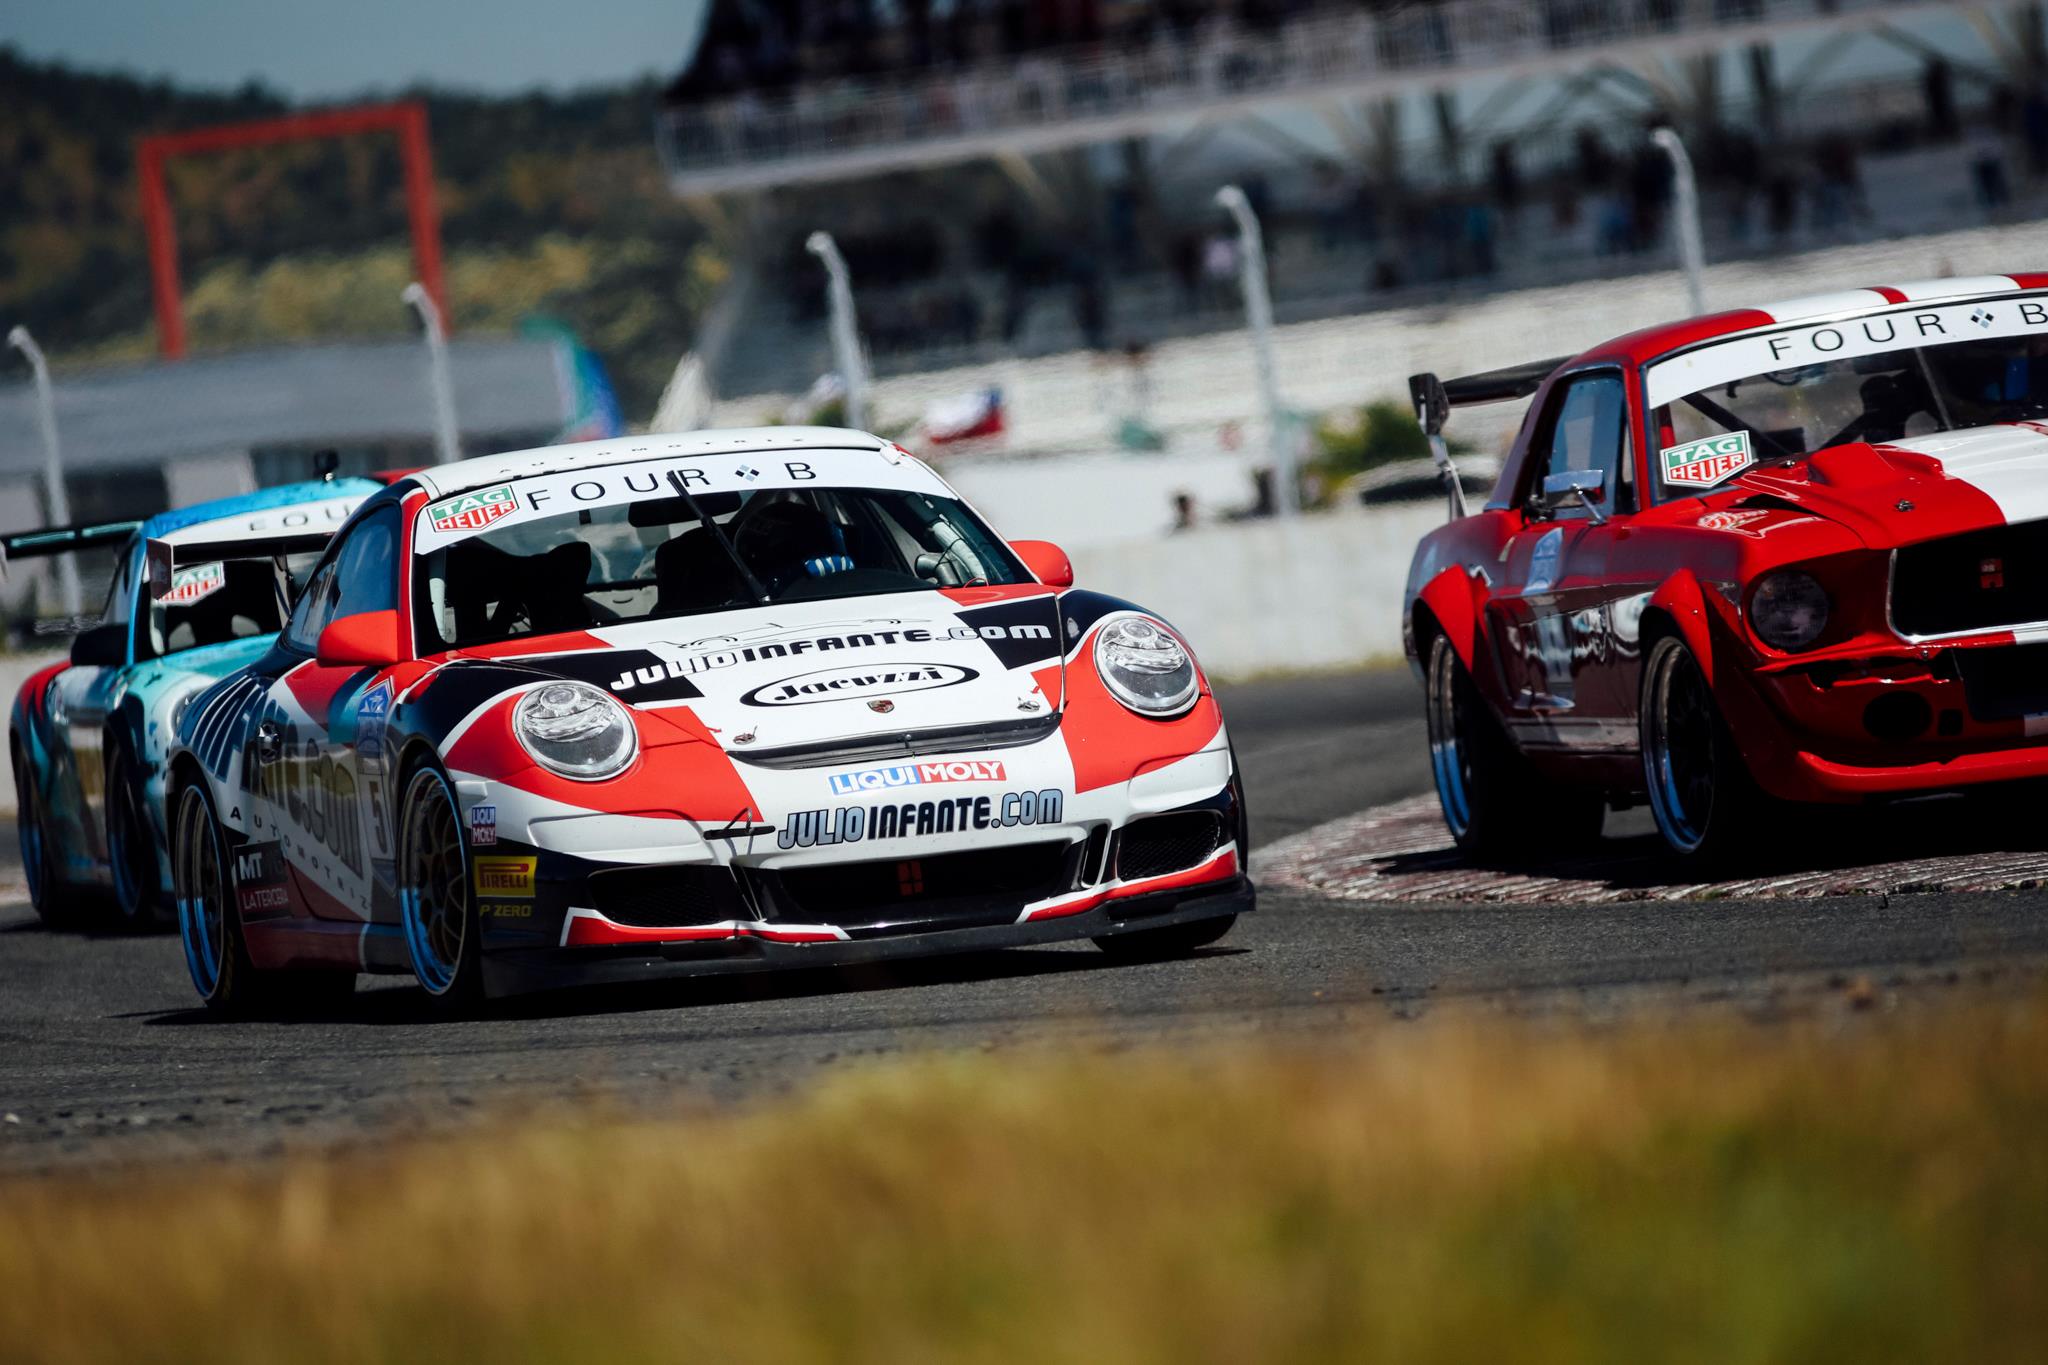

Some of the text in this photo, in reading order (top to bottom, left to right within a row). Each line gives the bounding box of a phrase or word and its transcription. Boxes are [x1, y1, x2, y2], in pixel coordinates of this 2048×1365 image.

[1768, 303, 2048, 361] FOUR B
[1671, 434, 1740, 464] TAG
[1671, 452, 1745, 483] HEUER
[526, 462, 817, 511] FOUR B
[434, 488, 506, 517] TAG
[437, 501, 516, 530] HEUER
[249, 503, 351, 532] FOU
[174, 562, 219, 588] AG
[774, 666, 944, 701] Jacuzzi
[832, 761, 1005, 794] LIQUI MOLY
[472, 807, 496, 825] LIQUI
[472, 826, 496, 844] MOLY
[478, 863, 530, 889] PIRELLI
[480, 904, 532, 918] P ZERO
